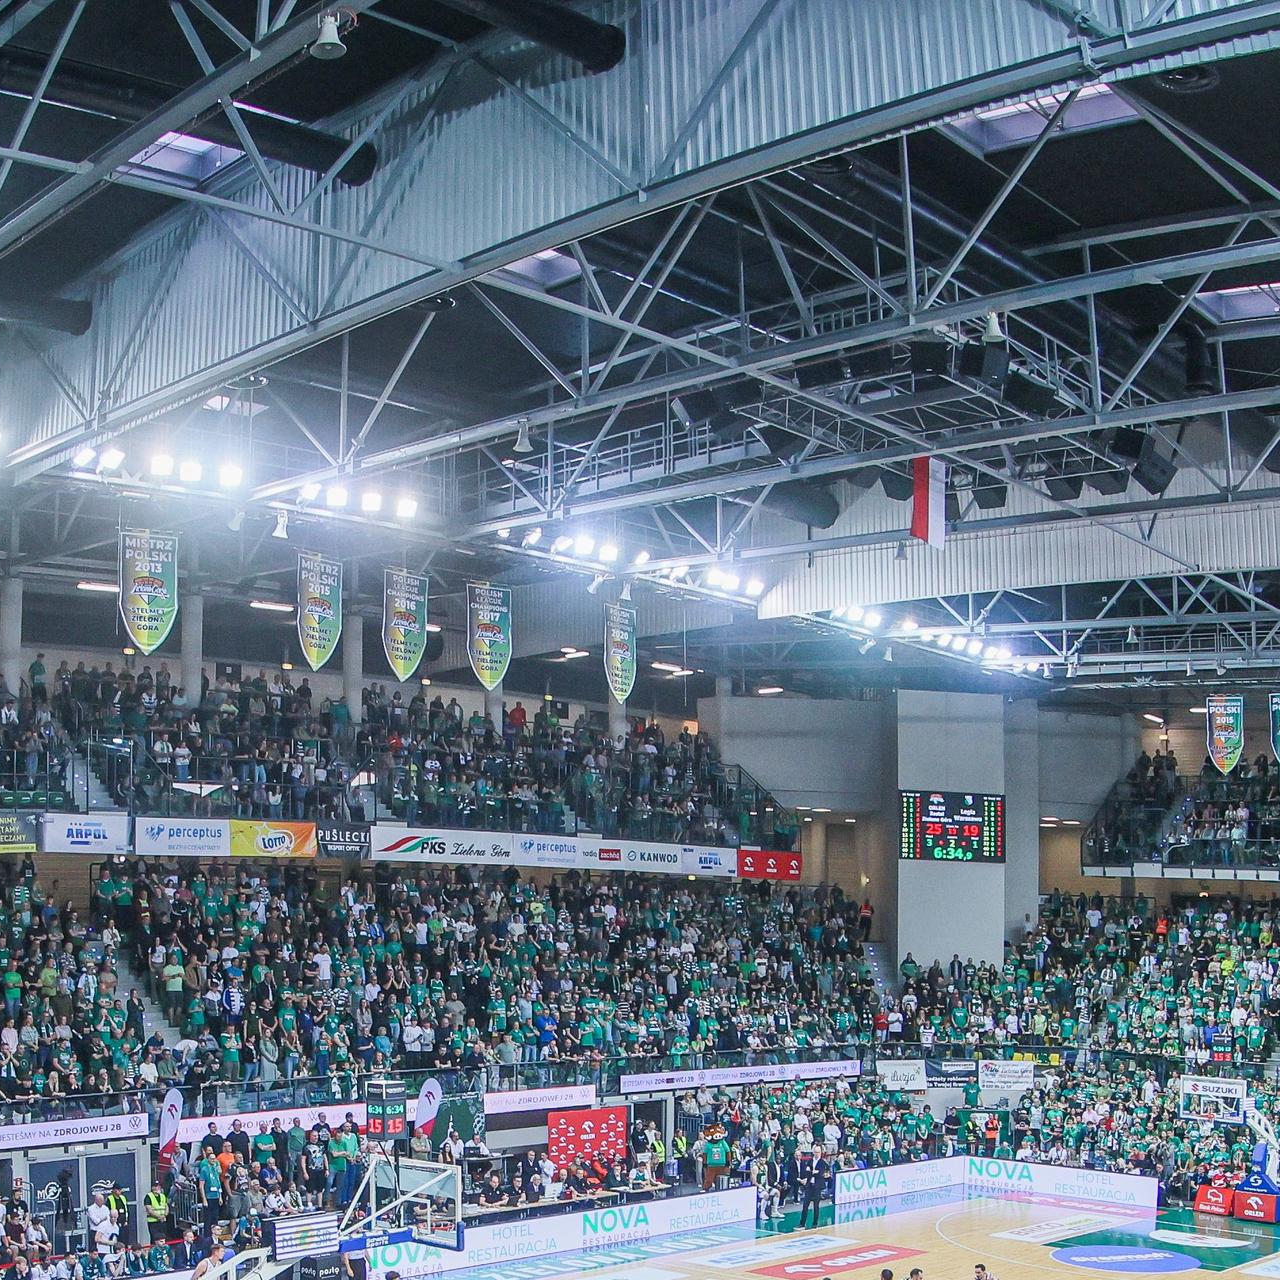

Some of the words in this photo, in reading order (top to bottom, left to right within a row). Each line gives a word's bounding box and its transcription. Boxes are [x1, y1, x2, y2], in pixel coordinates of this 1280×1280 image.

[125, 537, 173, 550] MISTRZ
[125, 549, 172, 562] POLSKI
[135, 562, 162, 573] 2013
[301, 560, 338, 576] MISTRZ
[301, 571, 337, 587] POLSKI
[392, 574, 420, 586] POLISH
[308, 584, 330, 595] 2015
[387, 588, 424, 602] CHAMPIONS
[475, 589, 503, 599] POLISH
[394, 599, 416, 610] 2016
[470, 602, 508, 613] CHAMPIONS
[477, 611, 500, 622] 2017
[1209, 706, 1241, 714] POLSKI
[1215, 716, 1234, 724] 2015
[66, 828, 108, 839] ARPOL
[168, 826, 222, 840] perceptus
[926, 823, 942, 834] 25
[963, 825, 979, 836] 19
[420, 841, 446, 855] PKS
[450, 842, 486, 857] Zielona
[490, 844, 510, 858] Góra
[537, 842, 576, 854] perceptus
[640, 851, 678, 863] KANWOD
[1202, 1085, 1238, 1095] SUZUKI
[385, 1104, 404, 1114] 6:34
[39, 1129, 52, 1138] NA
[53, 1125, 109, 1137] ZDROJOWEJ
[368, 1118, 383, 1133] 15
[386, 1118, 404, 1133] 15
[915, 1163, 939, 1175] HOTEL
[968, 1159, 1033, 1183] NOVA
[839, 1170, 888, 1194] NOVA
[901, 1174, 953, 1191] RESTAURACJA
[1076, 1171, 1114, 1186] HOTEL
[1054, 1184, 1136, 1203] RESTAURACJA
[689, 1196, 722, 1210] HOTEL
[671, 1208, 740, 1230] RESTAURACJA
[1244, 1209, 1265, 1218] ORLEN
[582, 1205, 649, 1236] NOVA
[492, 1224, 534, 1239] HOTEL
[582, 1228, 651, 1246] RESTAURACJA
[468, 1238, 557, 1263] RESTAURACJA
[822, 1248, 897, 1267] ORLEN
